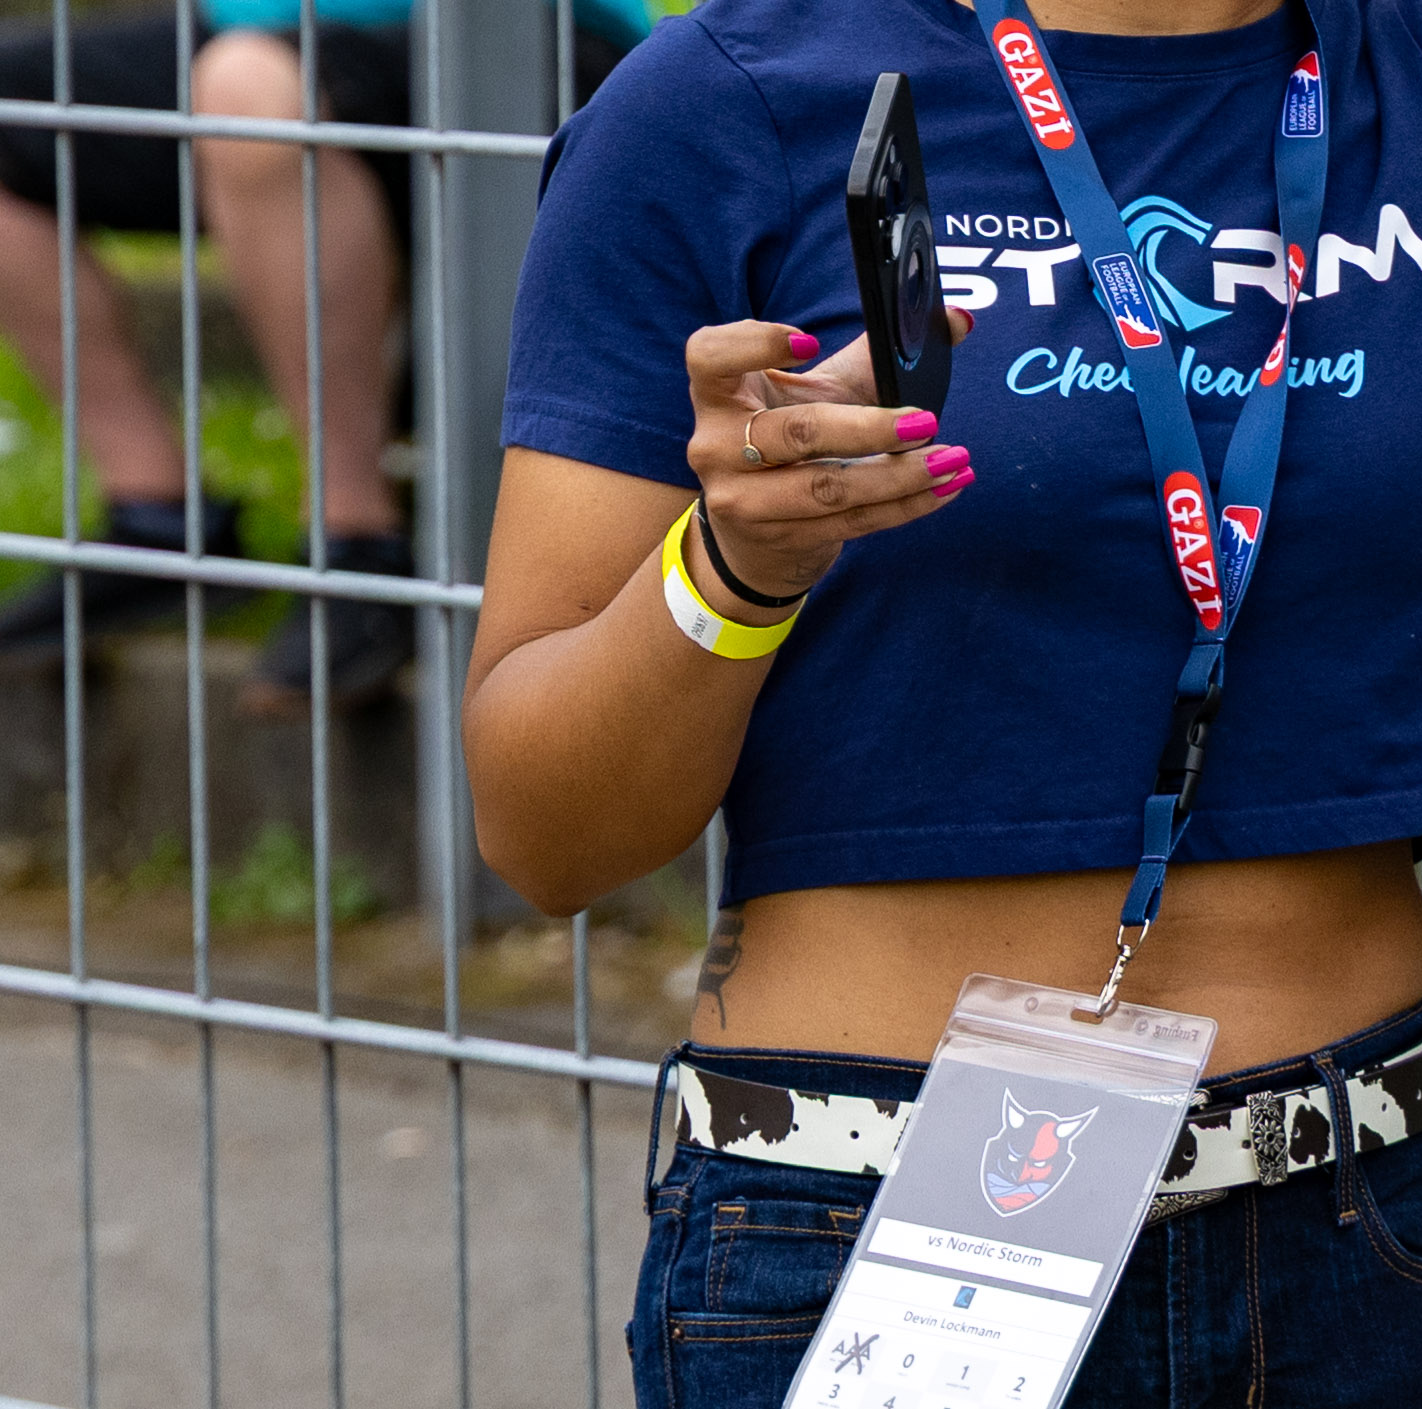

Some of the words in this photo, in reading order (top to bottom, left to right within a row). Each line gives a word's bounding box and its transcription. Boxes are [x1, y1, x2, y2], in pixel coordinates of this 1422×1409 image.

[1307, 90, 1317, 130] FOOTBALL
[945, 214, 1072, 240] NORDI
[1100, 264, 1124, 306] FOOTBALL
[1109, 262, 1128, 293] LEAGUE
[1118, 261, 1142, 305] EUROPEAN
[1006, 345, 1366, 399] Cheleaing
[927, 1234, 944, 1248] vs
[946, 1236, 996, 1259] Nordic
[997, 1246, 1043, 1268] Storm
[903, 1310, 938, 1328] Devin
[940, 1318, 1001, 1340] Lockmann
[828, 1383, 841, 1399] 3
[902, 1354, 915, 1369] 0
[961, 1364, 970, 1381] 1
[1012, 1376, 1026, 1393] 2
